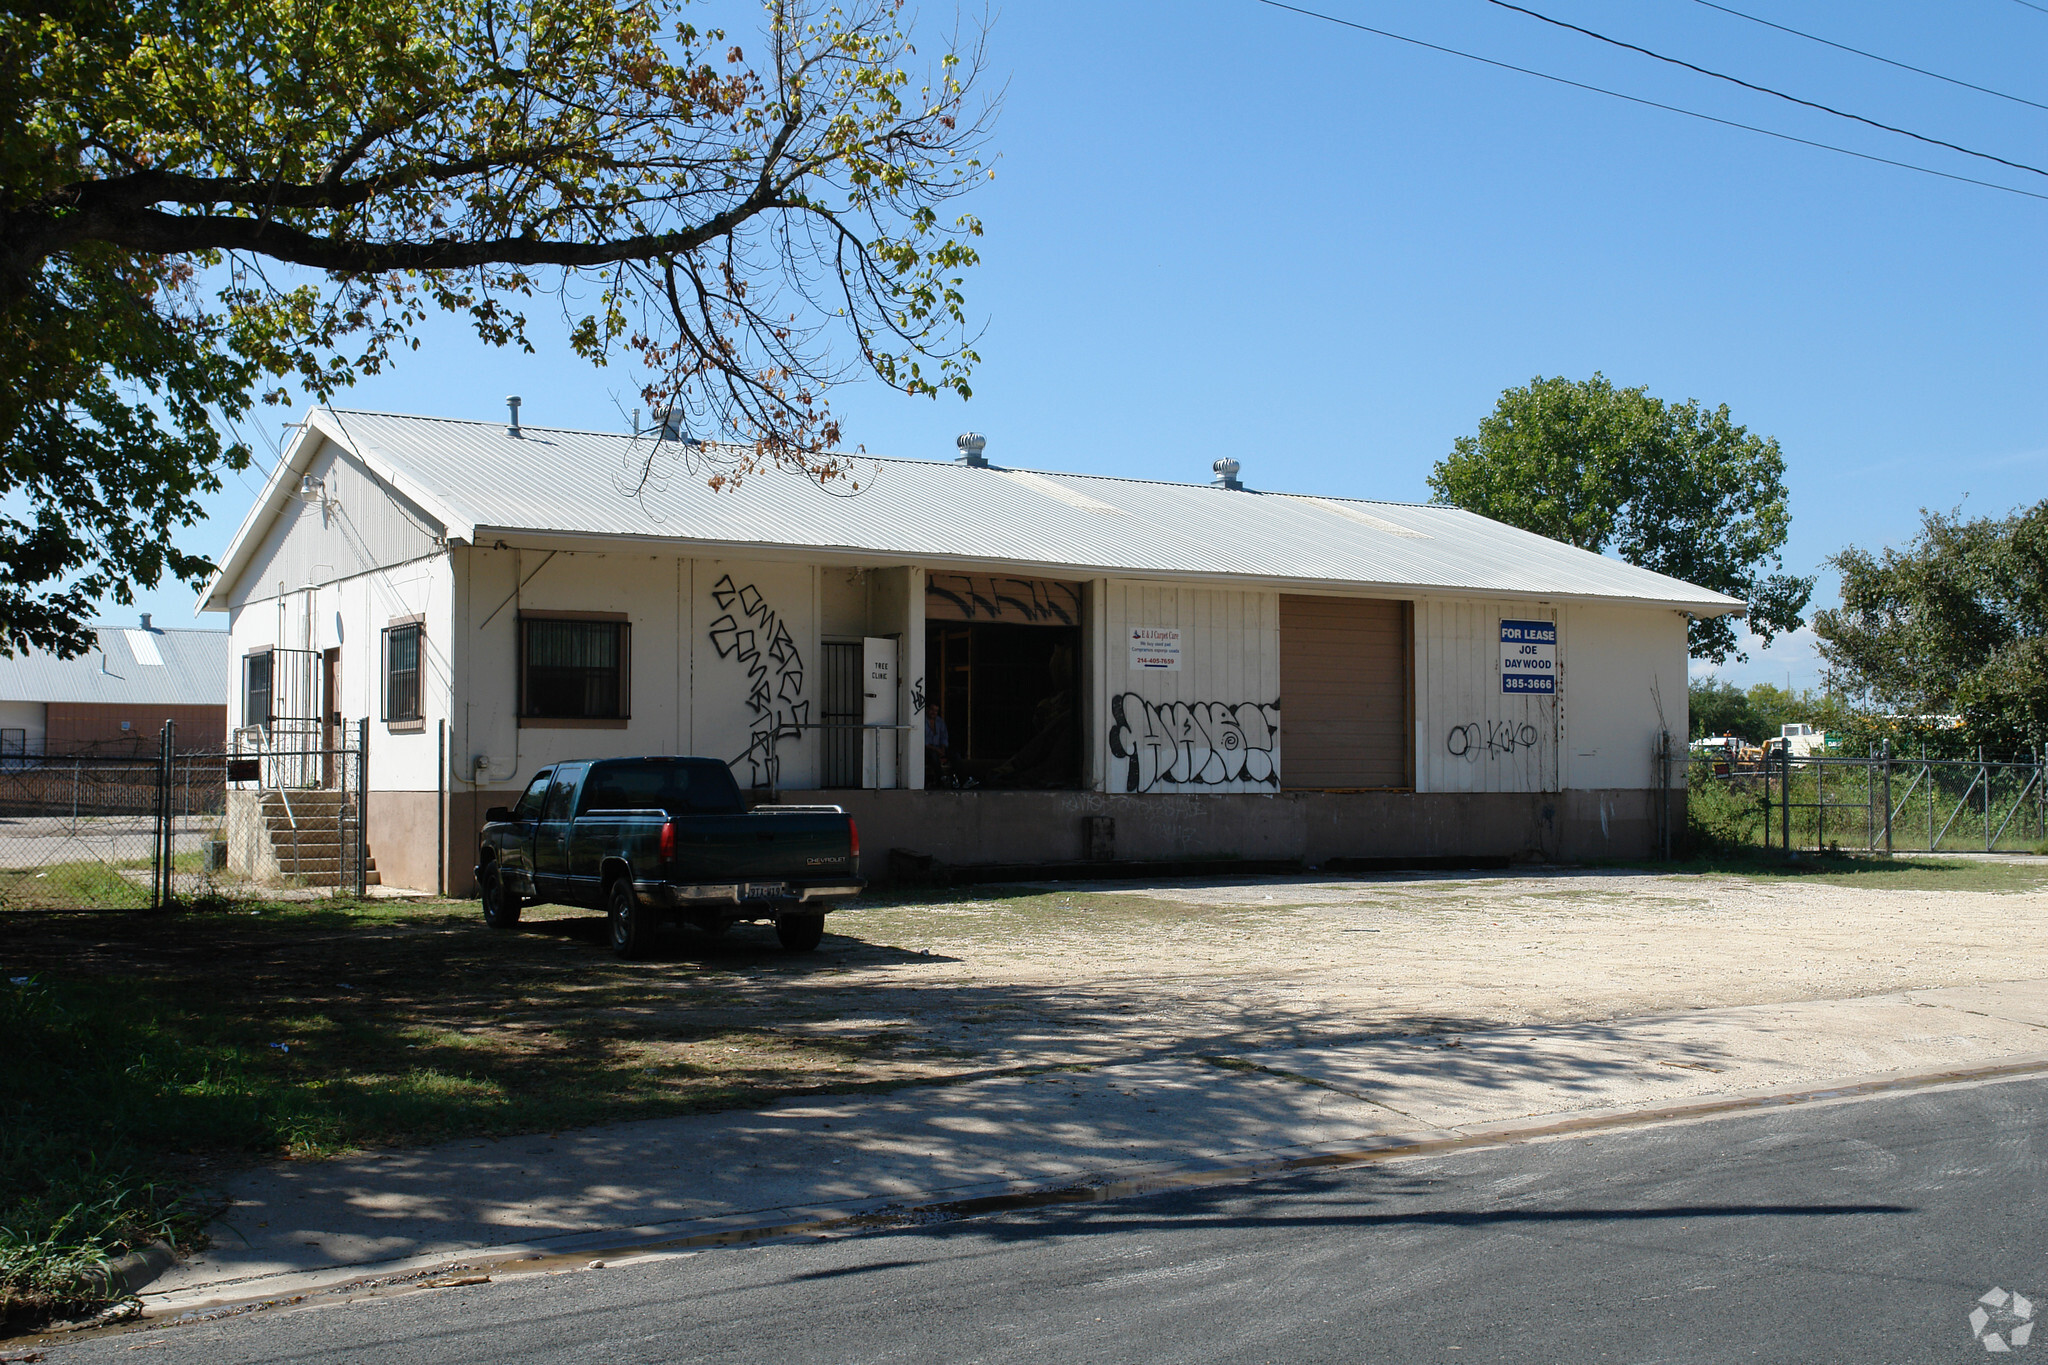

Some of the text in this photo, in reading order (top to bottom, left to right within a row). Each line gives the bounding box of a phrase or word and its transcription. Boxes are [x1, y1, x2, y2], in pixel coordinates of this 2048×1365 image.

[1141, 630, 1146, 639] E
[1154, 630, 1168, 641] Carpet
[1501, 628, 1555, 641] FOR LEASE
[1519, 645, 1537, 655] JOE
[875, 662, 888, 670] TREE
[1505, 659, 1551, 669] DAYWOOD
[872, 671, 887, 680] CLINIC
[1505, 678, 1552, 689] 385-3666
[806, 856, 846, 864] CHEVROLET
